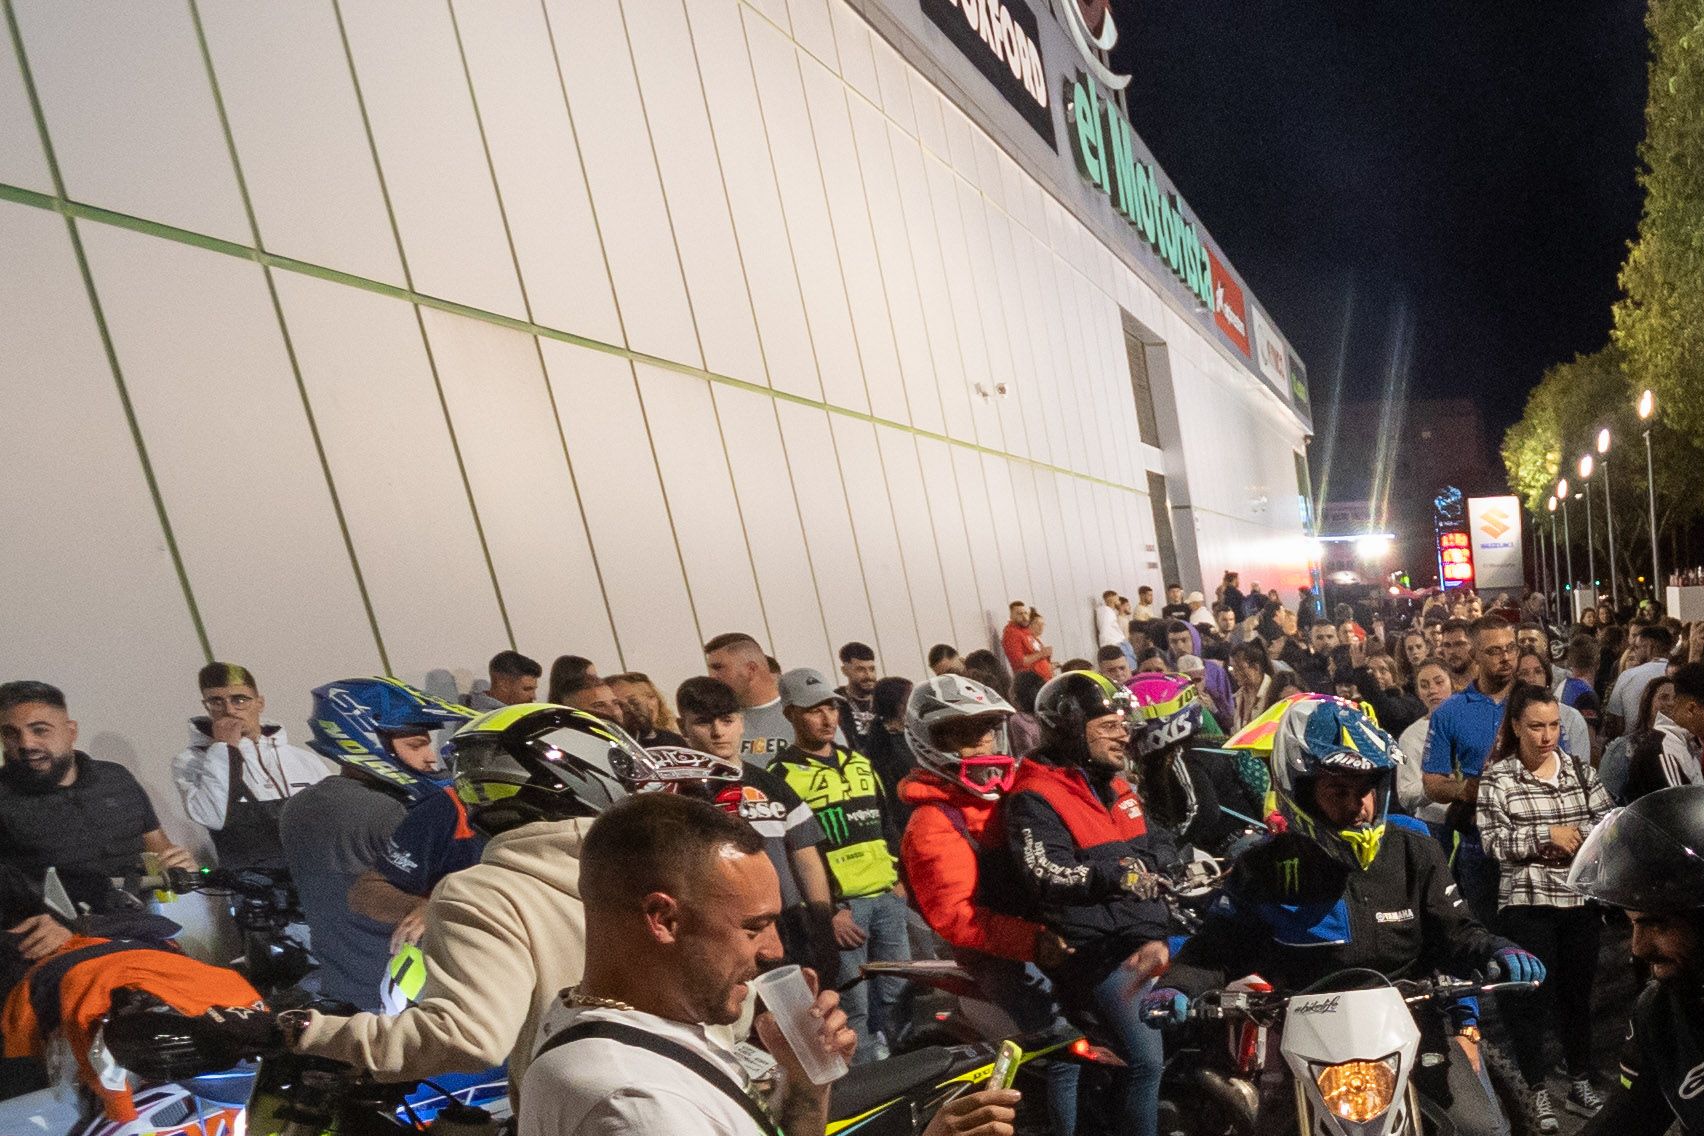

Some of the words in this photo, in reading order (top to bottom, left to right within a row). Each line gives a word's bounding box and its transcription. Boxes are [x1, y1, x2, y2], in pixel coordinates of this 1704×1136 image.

[1074, 72, 1110, 196] el
[1107, 99, 1214, 313] Motorista
[318, 719, 419, 785] NOLAN
[1325, 751, 1373, 771] Airoh
[803, 761, 876, 804] 46
[1383, 908, 1415, 922] YAMAHA
